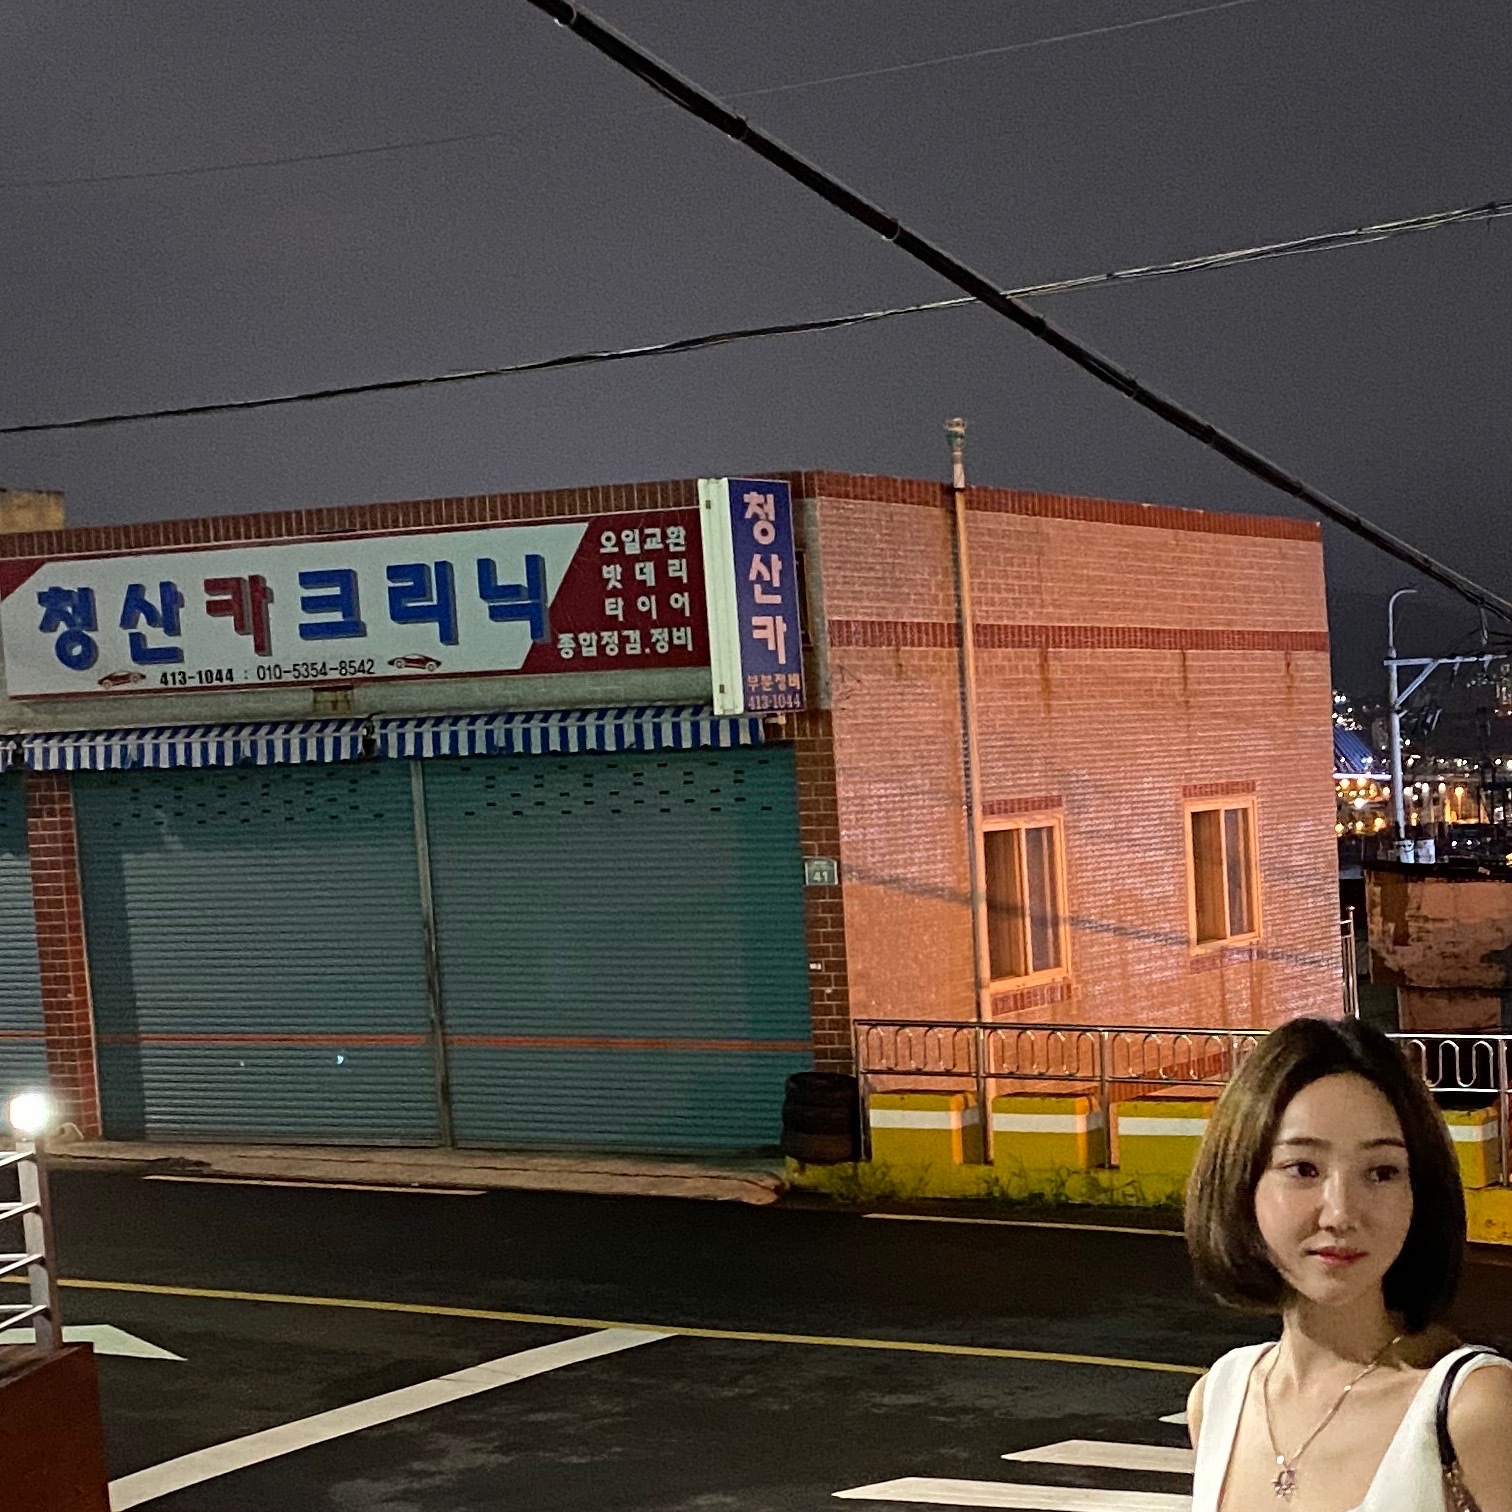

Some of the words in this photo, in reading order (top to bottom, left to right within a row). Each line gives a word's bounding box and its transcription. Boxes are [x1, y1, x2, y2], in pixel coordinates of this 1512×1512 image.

[600, 526, 687, 555] 오일교환
[743, 491, 787, 665] 청산카
[604, 592, 690, 622] 타이어
[160, 668, 234, 686] 413-1044
[256, 659, 375, 681] 010-5354-8542
[747, 673, 801, 692] 부분정비
[813, 871, 828, 882] 41
